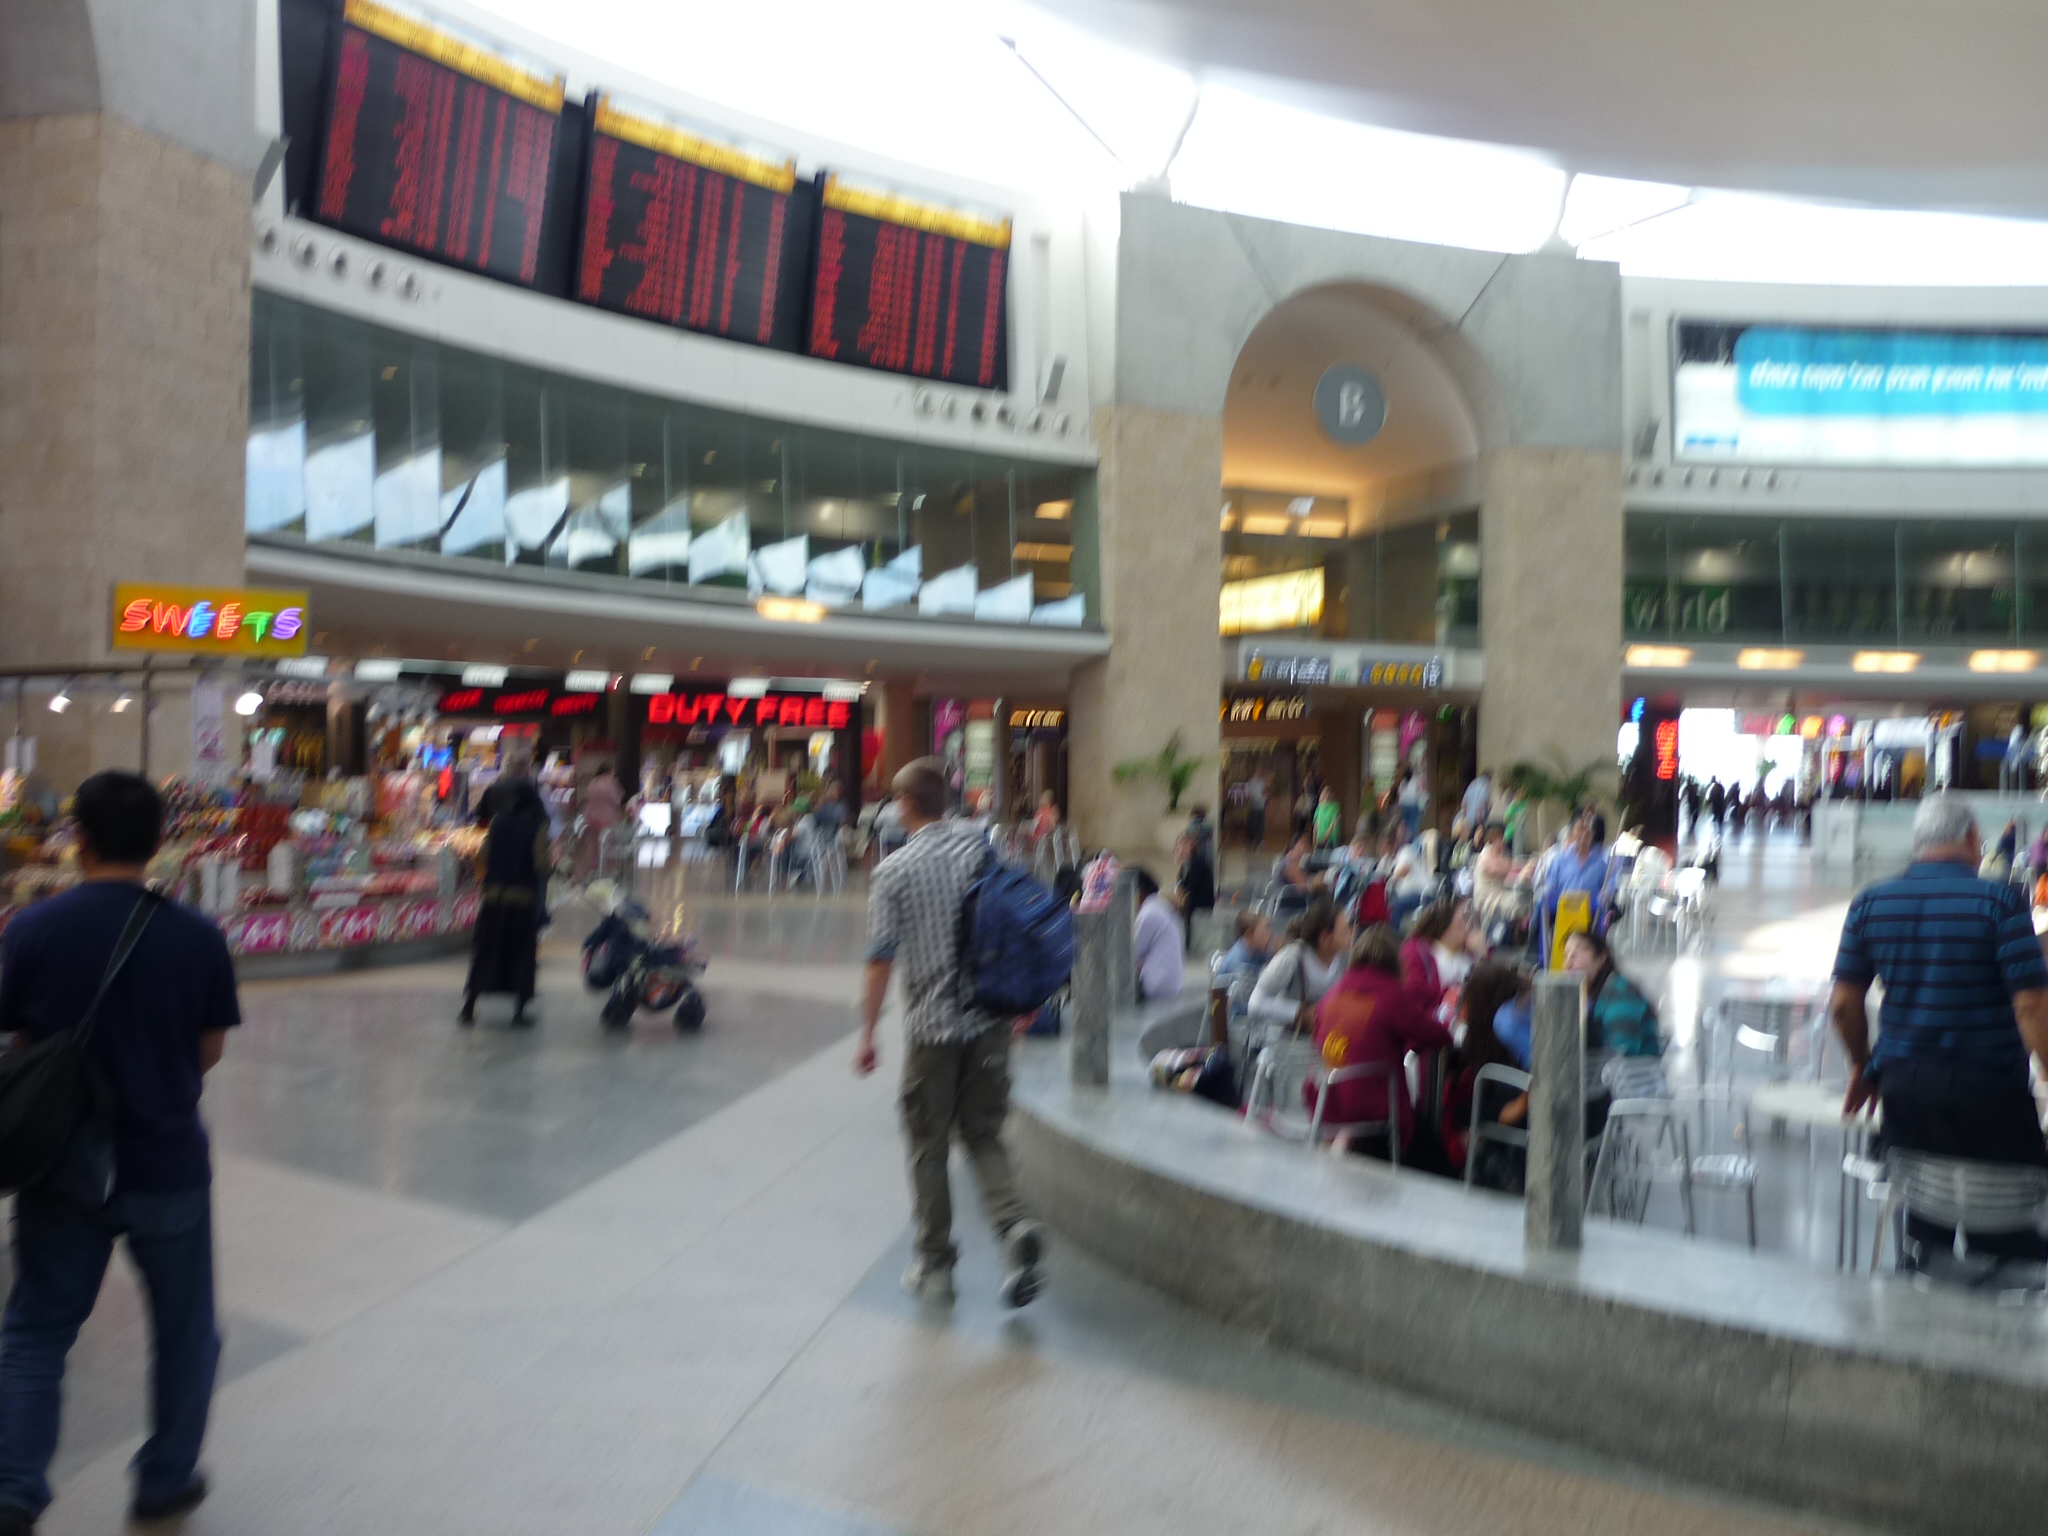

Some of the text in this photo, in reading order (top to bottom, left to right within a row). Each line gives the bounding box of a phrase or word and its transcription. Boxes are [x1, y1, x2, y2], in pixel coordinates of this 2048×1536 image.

[1339, 380, 1366, 428] B
[119, 598, 303, 643] SWEETS
[648, 692, 852, 730] DUTY FREE
